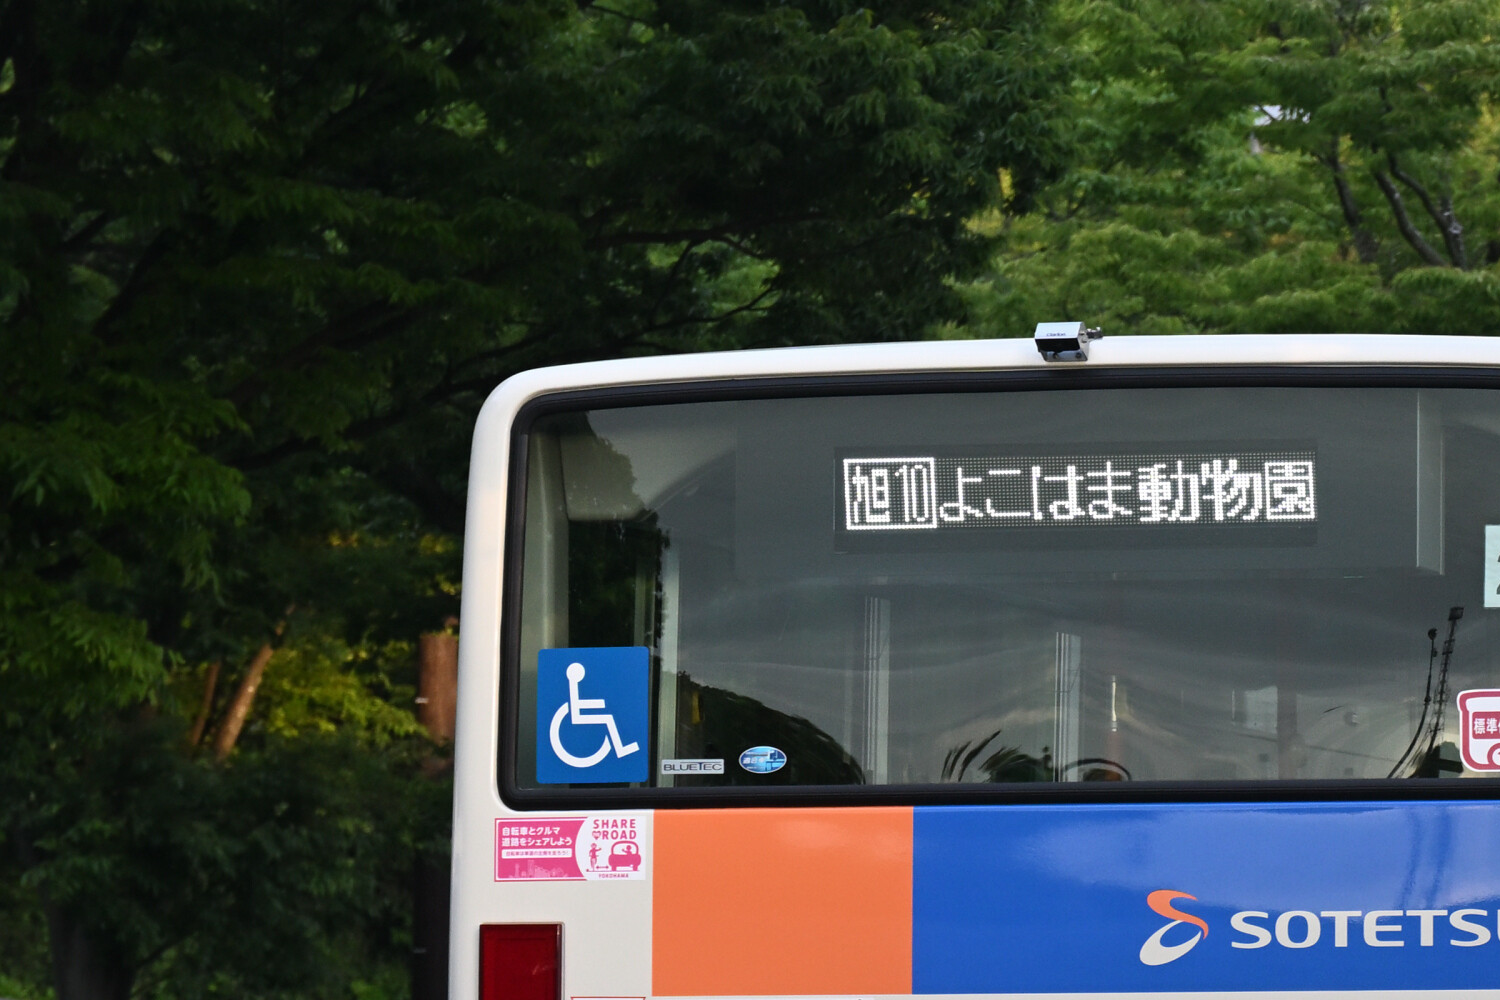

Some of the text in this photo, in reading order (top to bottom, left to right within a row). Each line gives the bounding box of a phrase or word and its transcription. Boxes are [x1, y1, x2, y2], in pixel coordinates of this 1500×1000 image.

[851, 459, 1316, 524] 旭10 よこはま動物園
[663, 762, 722, 771] BLUETEC
[593, 818, 636, 829] SHARE
[502, 827, 560, 836] 自転車とクルマ
[602, 830, 637, 840] ROAD
[502, 837, 572, 847] 道路をシェアしよう
